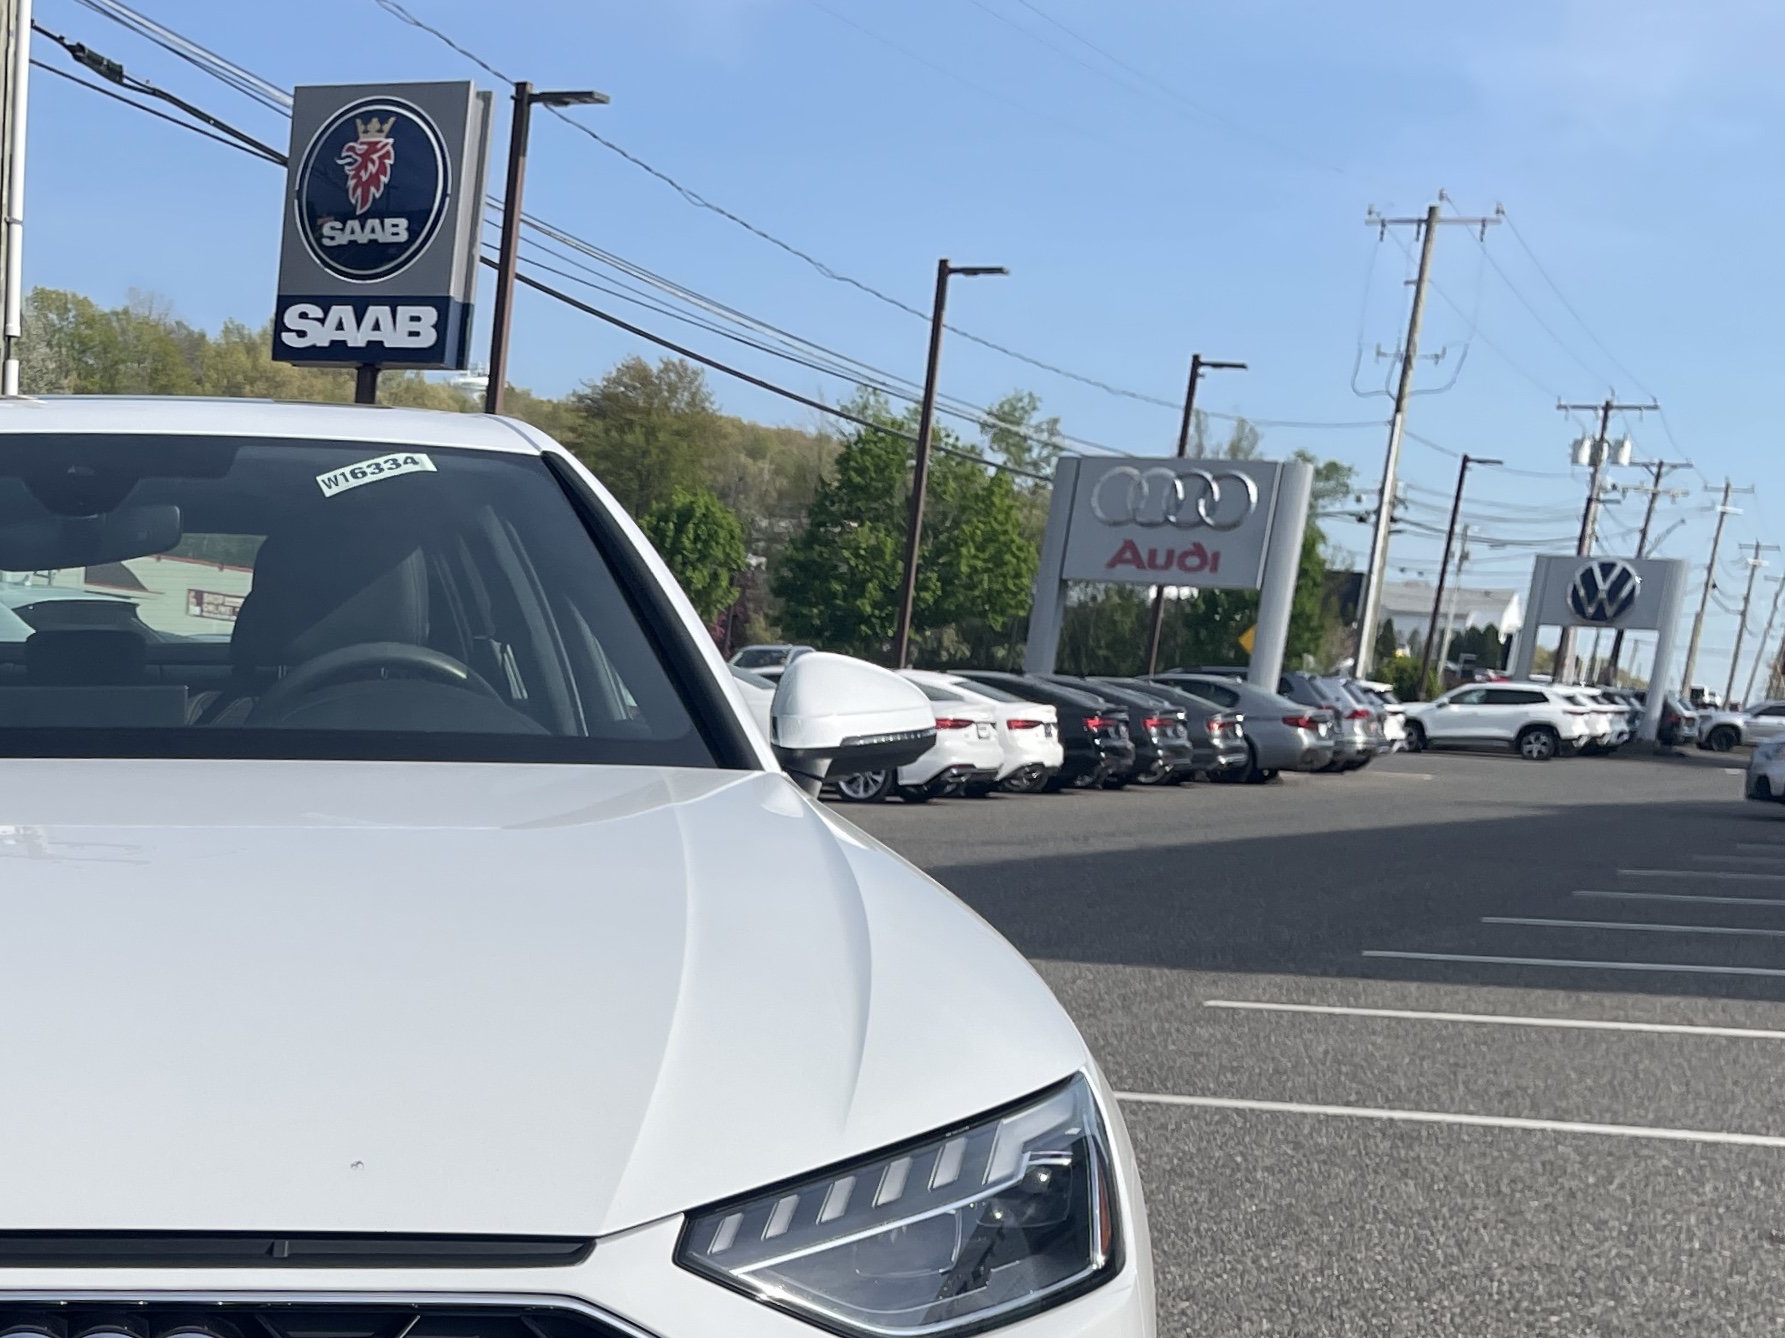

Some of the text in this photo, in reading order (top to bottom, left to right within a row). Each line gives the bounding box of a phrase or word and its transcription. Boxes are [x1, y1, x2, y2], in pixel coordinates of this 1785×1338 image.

[321, 217, 409, 246] SAAB
[280, 303, 438, 348] SAAB
[1105, 538, 1221, 574] Audi
